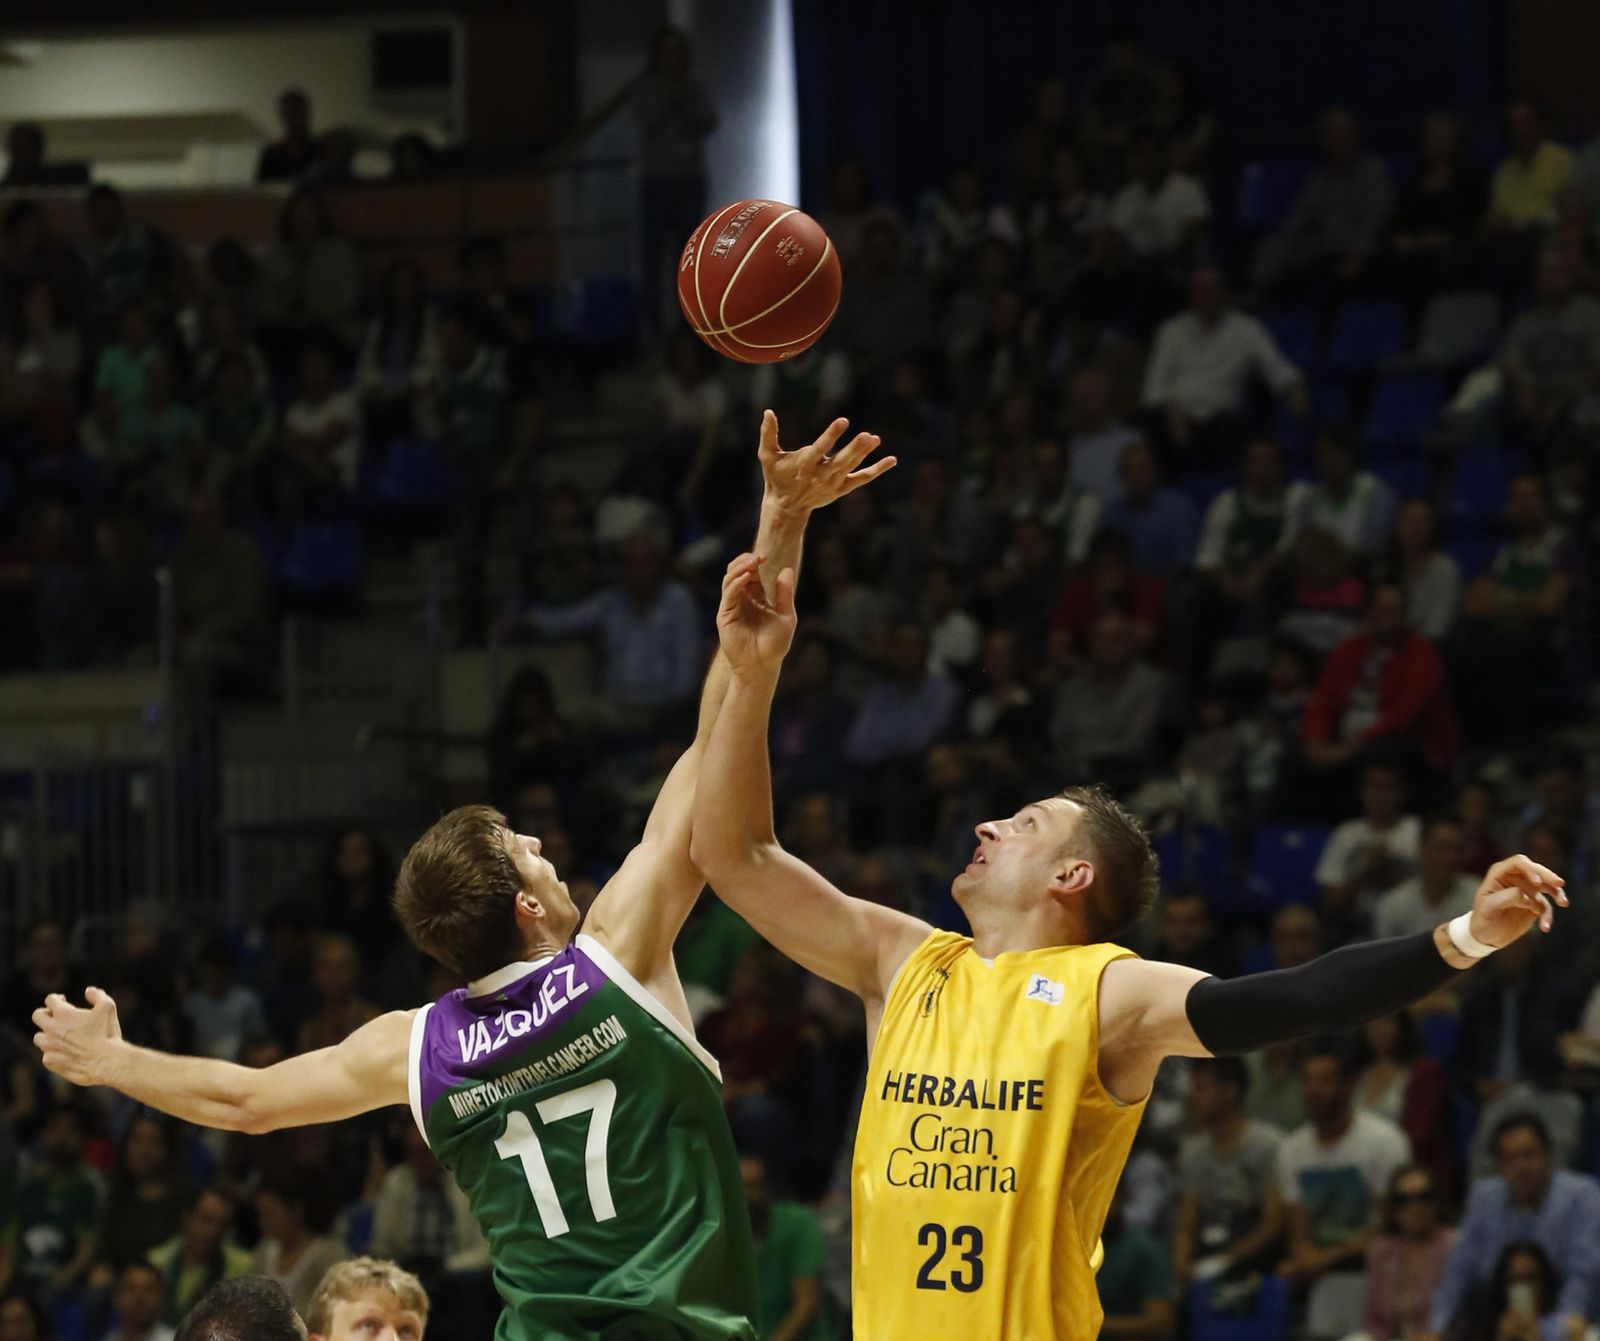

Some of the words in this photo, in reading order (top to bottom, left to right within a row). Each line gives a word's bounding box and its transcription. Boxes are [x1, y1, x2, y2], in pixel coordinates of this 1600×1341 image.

[881, 1070, 1044, 1111] HERBALIFE
[910, 1113, 993, 1155] Gran
[494, 1078, 617, 1239] 17
[887, 1147, 1018, 1193] Canaria
[916, 1223, 984, 1293] 23
